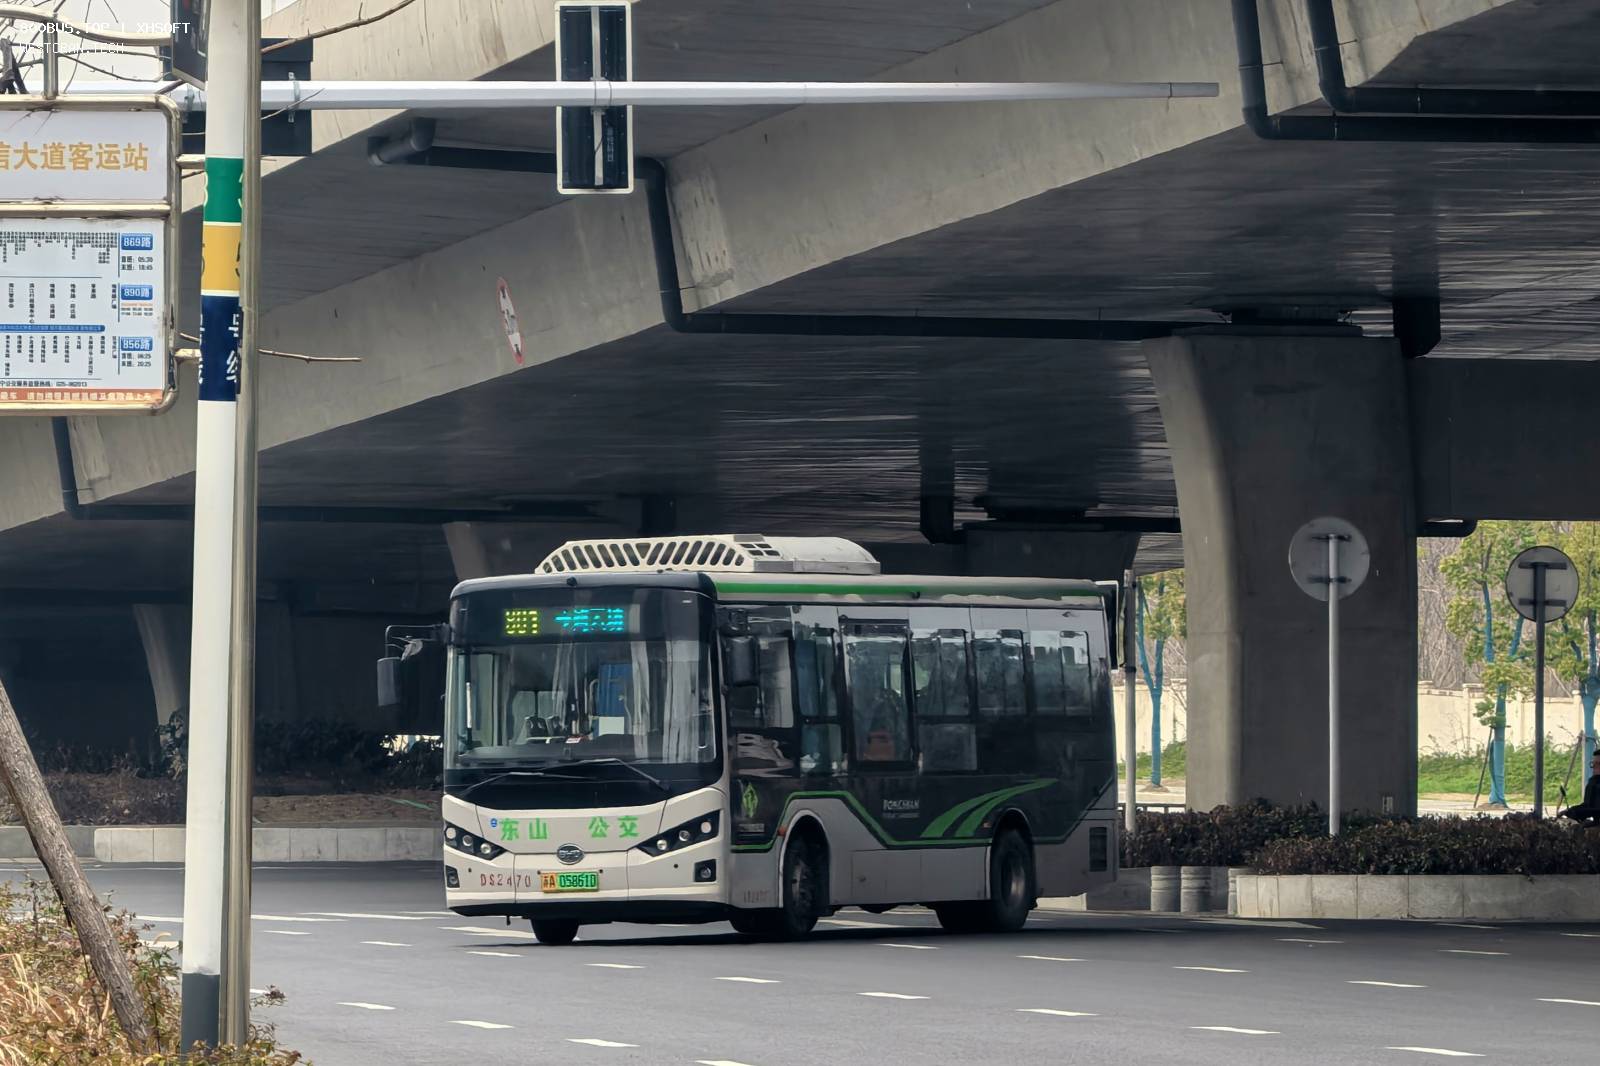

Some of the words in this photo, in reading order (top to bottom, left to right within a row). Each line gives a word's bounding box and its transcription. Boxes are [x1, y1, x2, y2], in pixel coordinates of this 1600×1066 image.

[123, 236, 151, 248] 869路
[124, 287, 150, 297] 890路
[123, 338, 150, 350] 856路
[499, 817, 548, 841] 东山
[588, 815, 640, 838] 公交
[480, 873, 532, 888] DS2470
